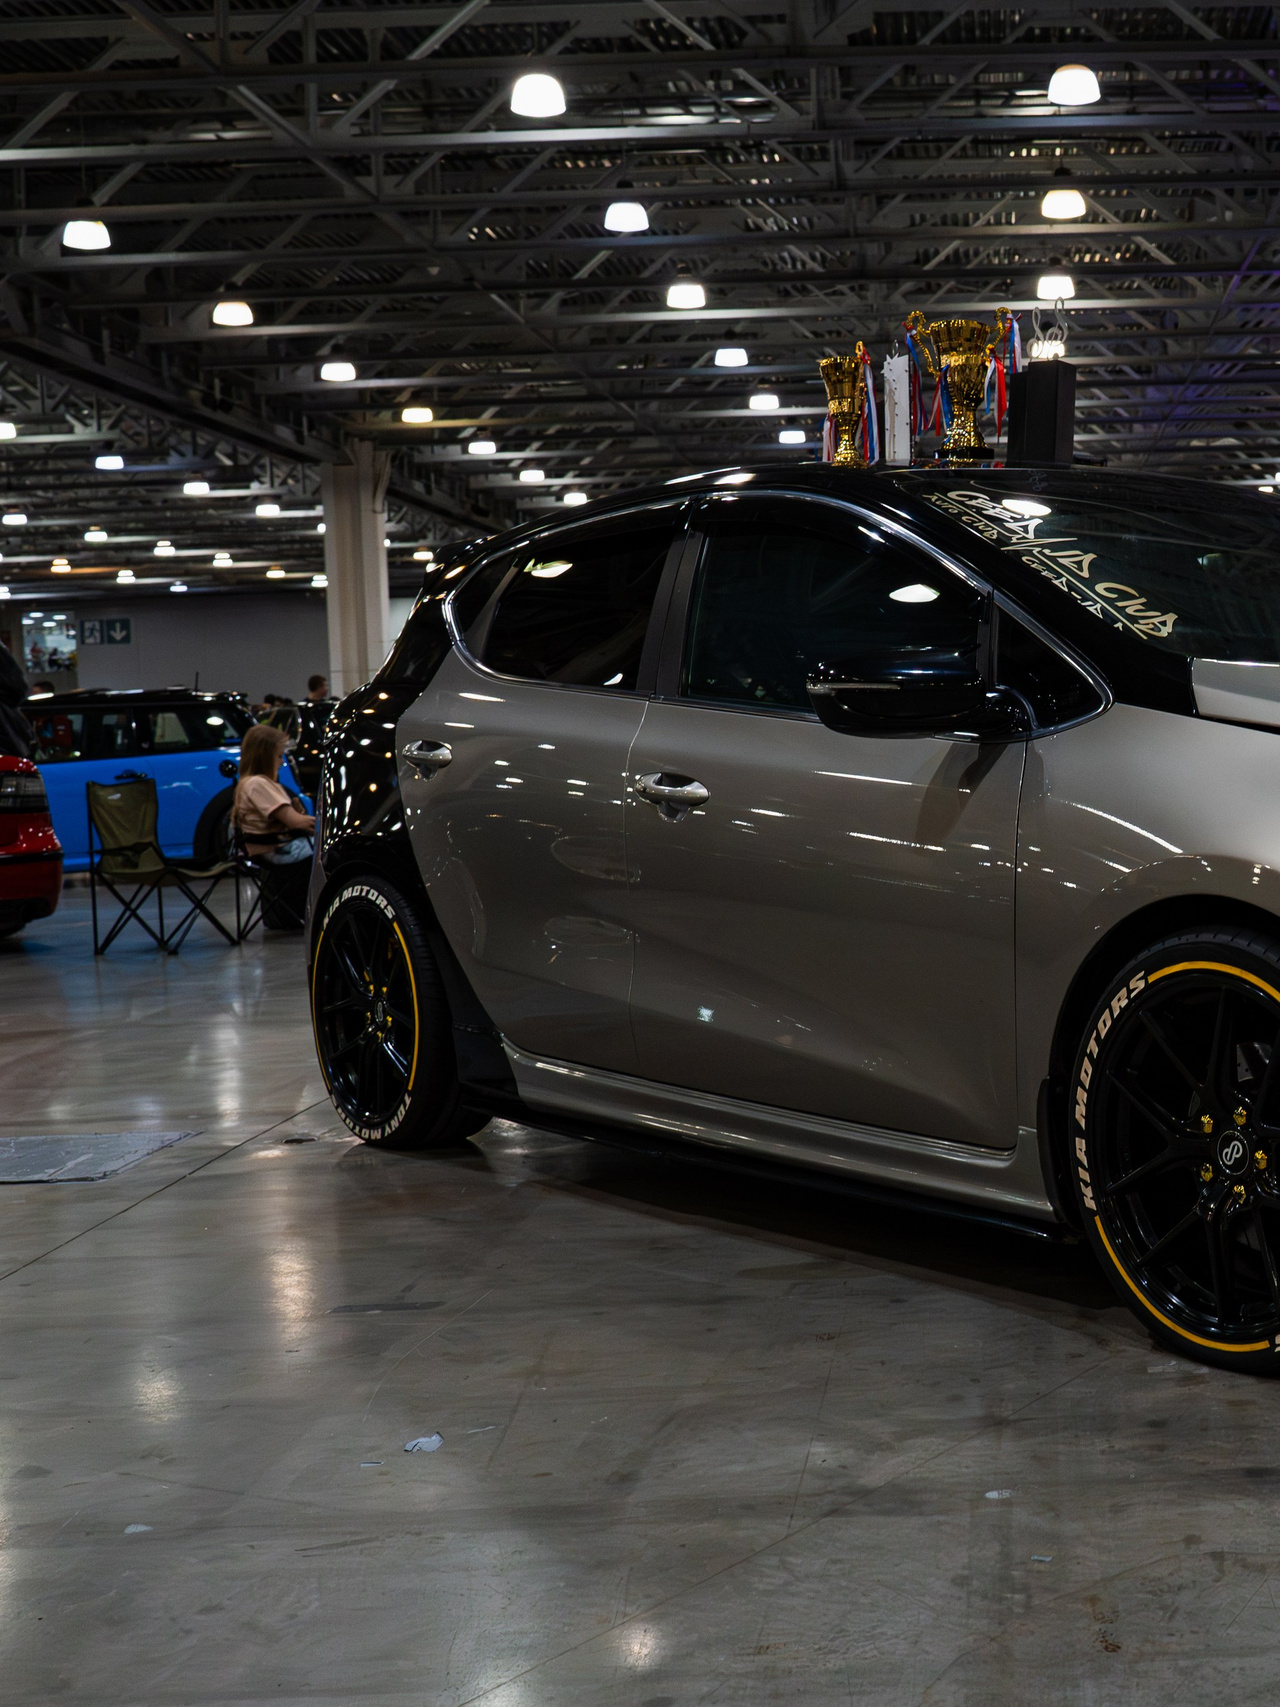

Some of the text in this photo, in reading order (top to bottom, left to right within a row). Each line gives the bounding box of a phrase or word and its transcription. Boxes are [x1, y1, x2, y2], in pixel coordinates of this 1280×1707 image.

[341, 885, 396, 919] MOTORS
[1075, 970, 1146, 1211] KIA MOTORS
[384, 1092, 412, 1137] TONY
